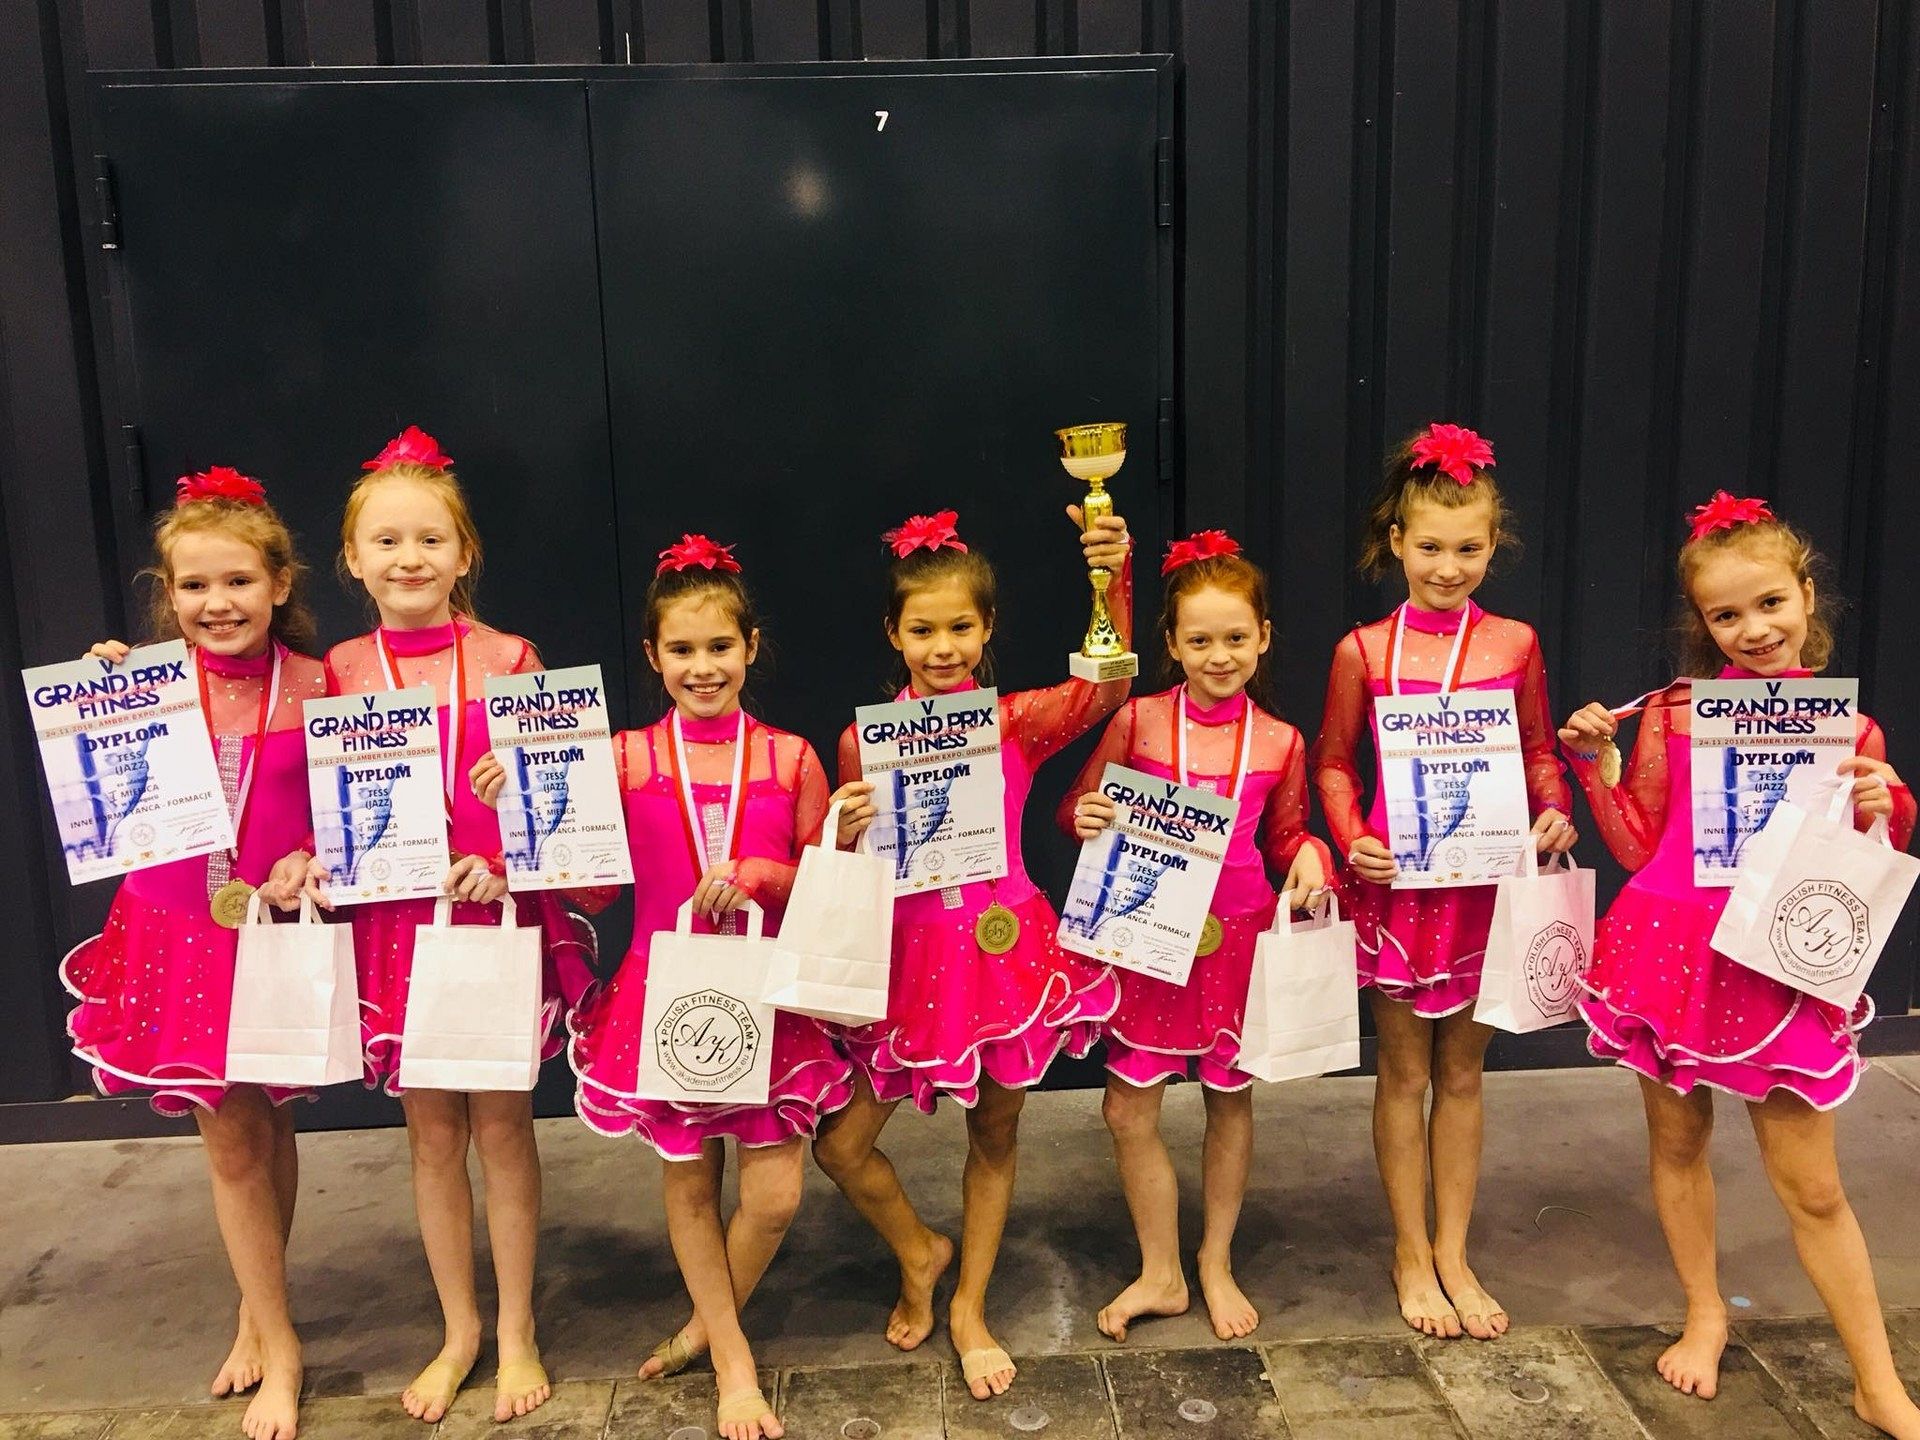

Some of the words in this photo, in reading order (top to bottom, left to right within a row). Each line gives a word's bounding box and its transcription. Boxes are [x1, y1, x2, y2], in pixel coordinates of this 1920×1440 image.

[875, 111, 889, 132] 7
[100, 660, 113, 674] V
[34, 674, 128, 708] GRAND
[132, 661, 187, 685] PRIX
[534, 675, 545, 691] V
[1766, 682, 1781, 696] V
[78, 692, 160, 719] FITNESS
[363, 696, 375, 711] V
[490, 692, 555, 718] GRAND
[558, 687, 600, 709] PRIX
[921, 700, 934, 715] V
[1438, 696, 1450, 709] V
[1697, 698, 1788, 718] GRAND
[1795, 698, 1850, 719] PRIX
[100, 717, 129, 728] AMBER
[309, 712, 383, 738] GRAND
[388, 707, 432, 728] PRIX
[519, 713, 578, 733] FITNESS
[863, 716, 943, 744] GRAND
[947, 707, 994, 730] PRIX
[1382, 711, 1460, 731] GRAND
[1464, 708, 1511, 728] PRIX
[1735, 717, 1816, 734] FITNESS
[84, 724, 168, 752] DYPLOM
[343, 730, 408, 752] FITNESS
[899, 733, 968, 756] FITNESS
[1417, 730, 1485, 745] FITNESS
[117, 751, 143, 762] TESS
[523, 749, 584, 766] DYPLOM
[914, 756, 940, 764] AMBER
[1733, 753, 1815, 766] DYPLOM
[116, 761, 149, 774] (JAZZ)
[343, 766, 411, 784] DYPLOM
[900, 764, 970, 787] DYPLOM
[1418, 761, 1490, 775] DYPLOM
[544, 772, 564, 780] TESS
[368, 789, 388, 797] TESS
[544, 782, 568, 792] (JAZZ)
[924, 788, 946, 797] TESS
[1166, 783, 1179, 799] V
[1755, 783, 1787, 792] (JAZZ)
[921, 796, 949, 808] (JAZZ)
[1441, 791, 1470, 800] (JAZZ)
[70, 819, 93, 829] INNE
[168, 791, 212, 806] FORMACJE
[366, 799, 392, 809] (JAZZ)
[1104, 782, 1179, 818] GRAND
[1183, 805, 1230, 836] PRIX
[582, 824, 617, 832] FORMACJE
[1129, 811, 1195, 842] FITNESS
[403, 838, 438, 846] FORMACJE
[877, 844, 896, 852] INNE
[958, 827, 996, 838] FORMACJE
[1138, 832, 1164, 844] AMBER
[1119, 839, 1189, 871] DYPLOM
[1137, 865, 1158, 877] TESS
[1130, 873, 1158, 889] (JAZZ)
[1076, 898, 1094, 908] INNE
[1153, 922, 1191, 938] FORMACJE
[1782, 885, 1814, 912] POLISH
[1818, 884, 1860, 912] FITNESS
[1856, 915, 1865, 944] TEAM
[1528, 936, 1546, 971] POLISH
[1546, 926, 1572, 938] FITNESS
[661, 1003, 689, 1035] POLISH
[692, 995, 737, 1011] FITNESS
[737, 1012, 753, 1039] TEAM
